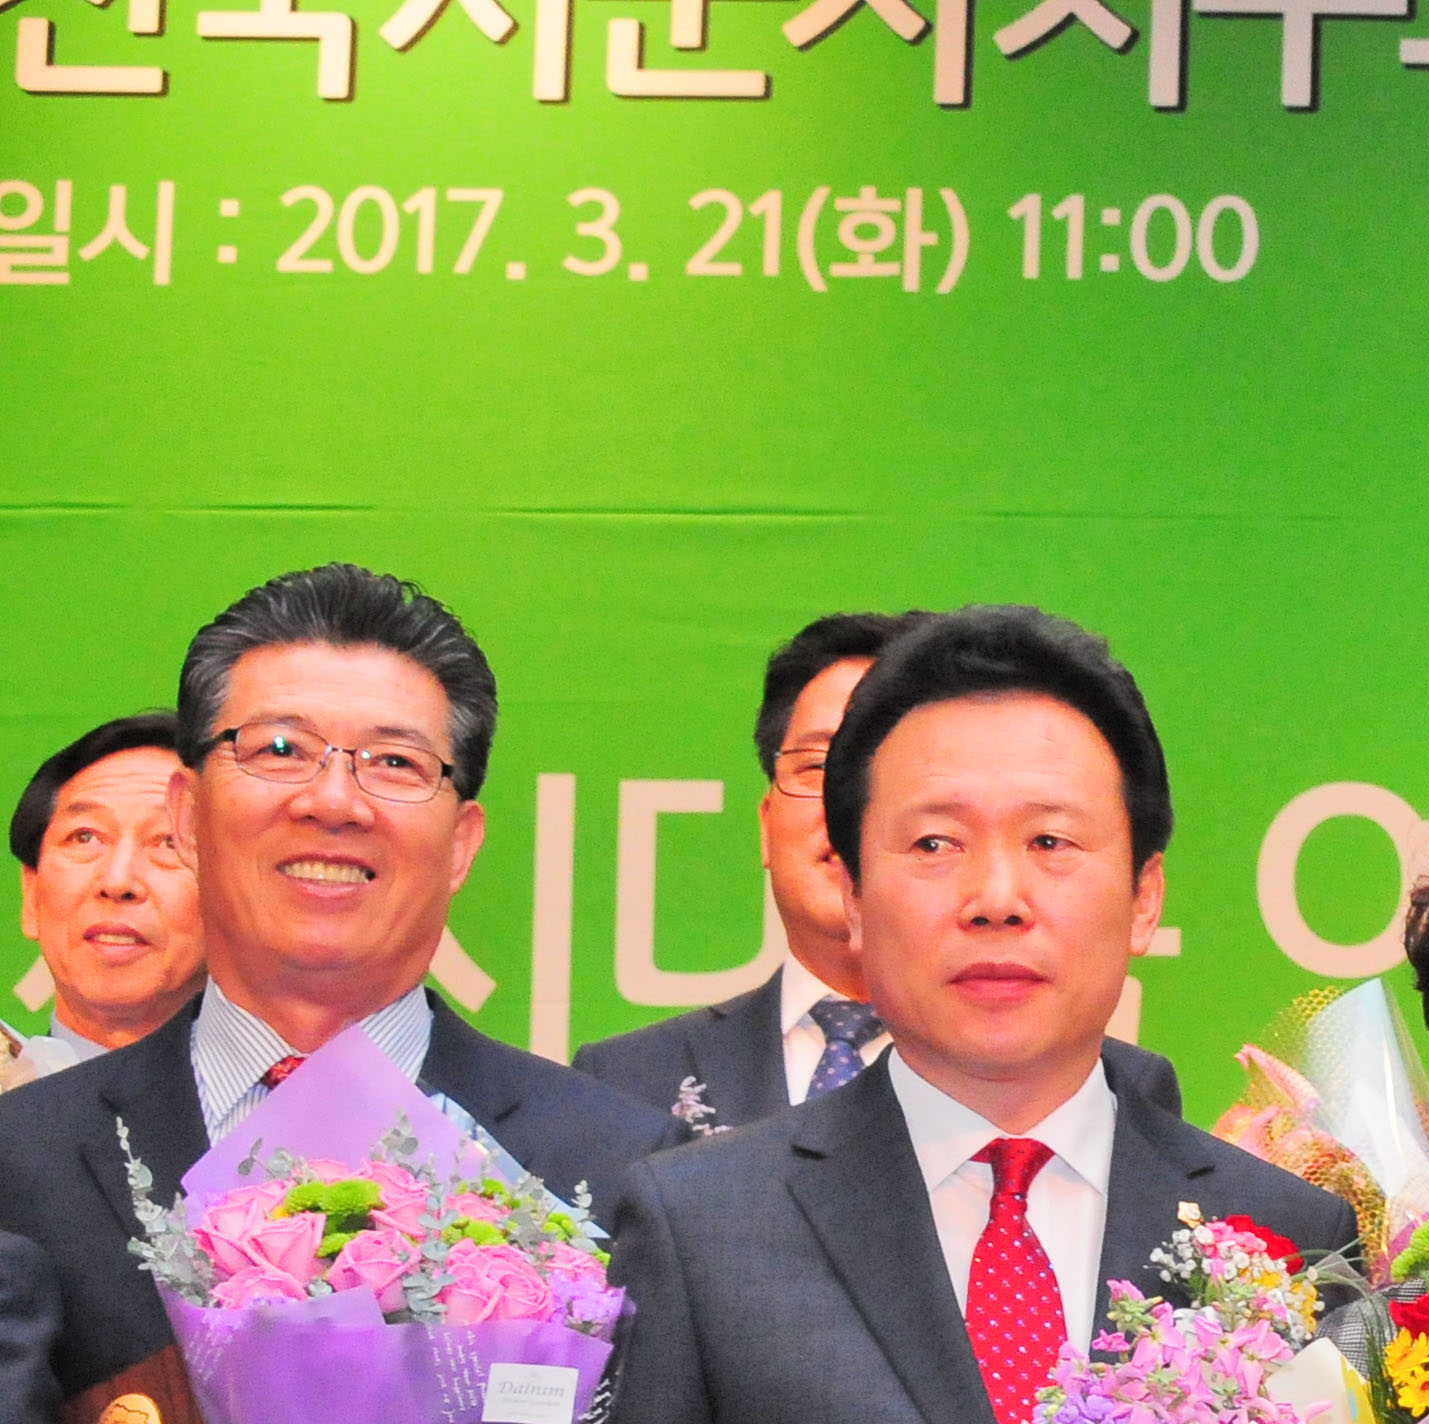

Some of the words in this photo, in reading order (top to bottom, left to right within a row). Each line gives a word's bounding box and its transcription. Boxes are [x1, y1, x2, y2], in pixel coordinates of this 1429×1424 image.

[0, 179, 175, 286] 일시
[275, 184, 527, 281] 2017.
[563, 185, 649, 282] 3.
[684, 185, 970, 294] 21(화)
[1008, 192, 1260, 283] 11:00
